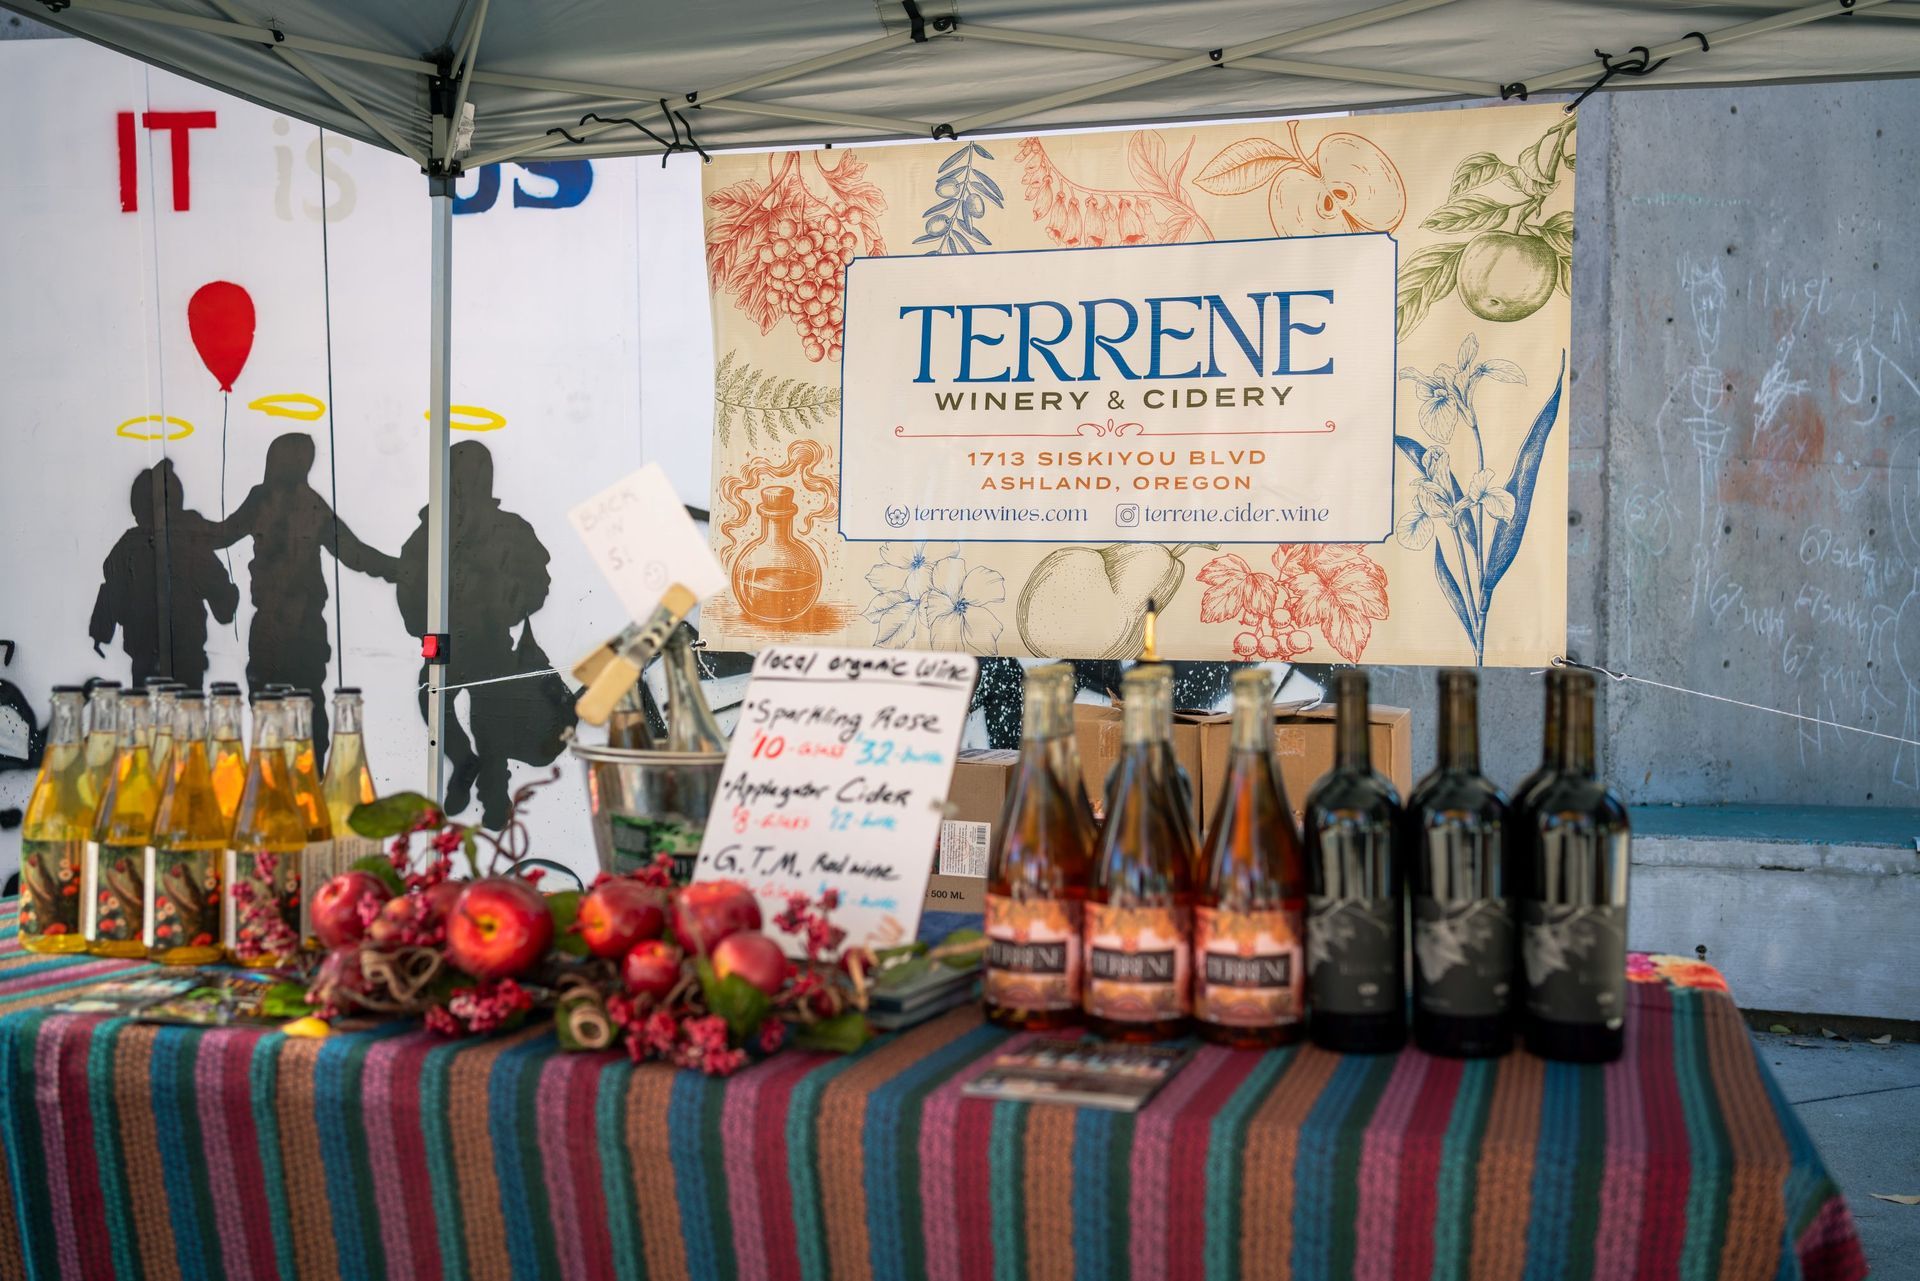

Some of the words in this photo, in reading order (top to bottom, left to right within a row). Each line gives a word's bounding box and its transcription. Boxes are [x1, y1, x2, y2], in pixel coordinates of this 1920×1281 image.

[118, 111, 216, 212] IT
[900, 289, 1334, 384] TERRENE
[935, 390, 1089, 411] WINERY
[1108, 390, 1126, 410] &
[1143, 386, 1294, 409] CIDERY
[967, 451, 1026, 467] 1713
[1038, 450, 1176, 467] SISKIYOU
[1189, 449, 1266, 466] BLVD
[981, 476, 1121, 493] ASHLAND,
[1132, 475, 1251, 491] OREGON
[914, 504, 1088, 523] terrenewines.com
[1144, 502, 1330, 523] terrene.cider.wine
[828, 655, 909, 679] organic
[752, 698, 863, 743] Sparkling
[930, 890, 948, 898] 500
[950, 891, 965, 899] ML
